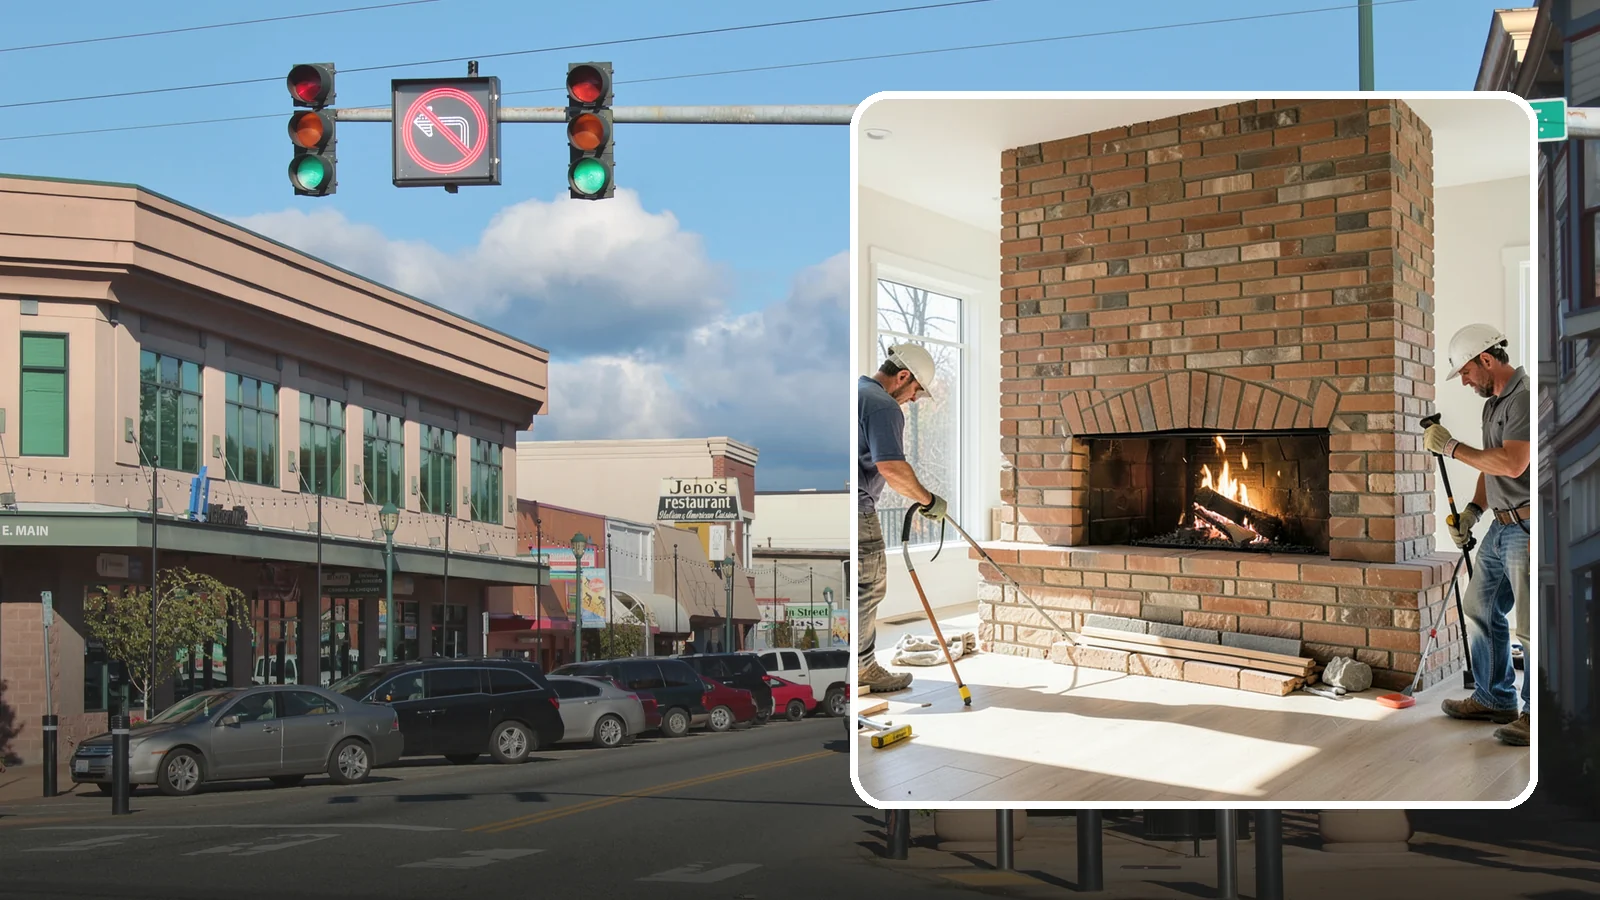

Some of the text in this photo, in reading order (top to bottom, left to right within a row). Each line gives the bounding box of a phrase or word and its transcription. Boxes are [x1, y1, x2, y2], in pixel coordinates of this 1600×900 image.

[670, 480, 727, 494] Jeno's
[665, 496, 730, 508] restaurant
[658, 510, 682, 519] Italian
[686, 510, 714, 519] American
[715, 510, 737, 518] Cuisine
[2, 526, 48, 536] E. MAIN
[797, 608, 828, 616] Street
